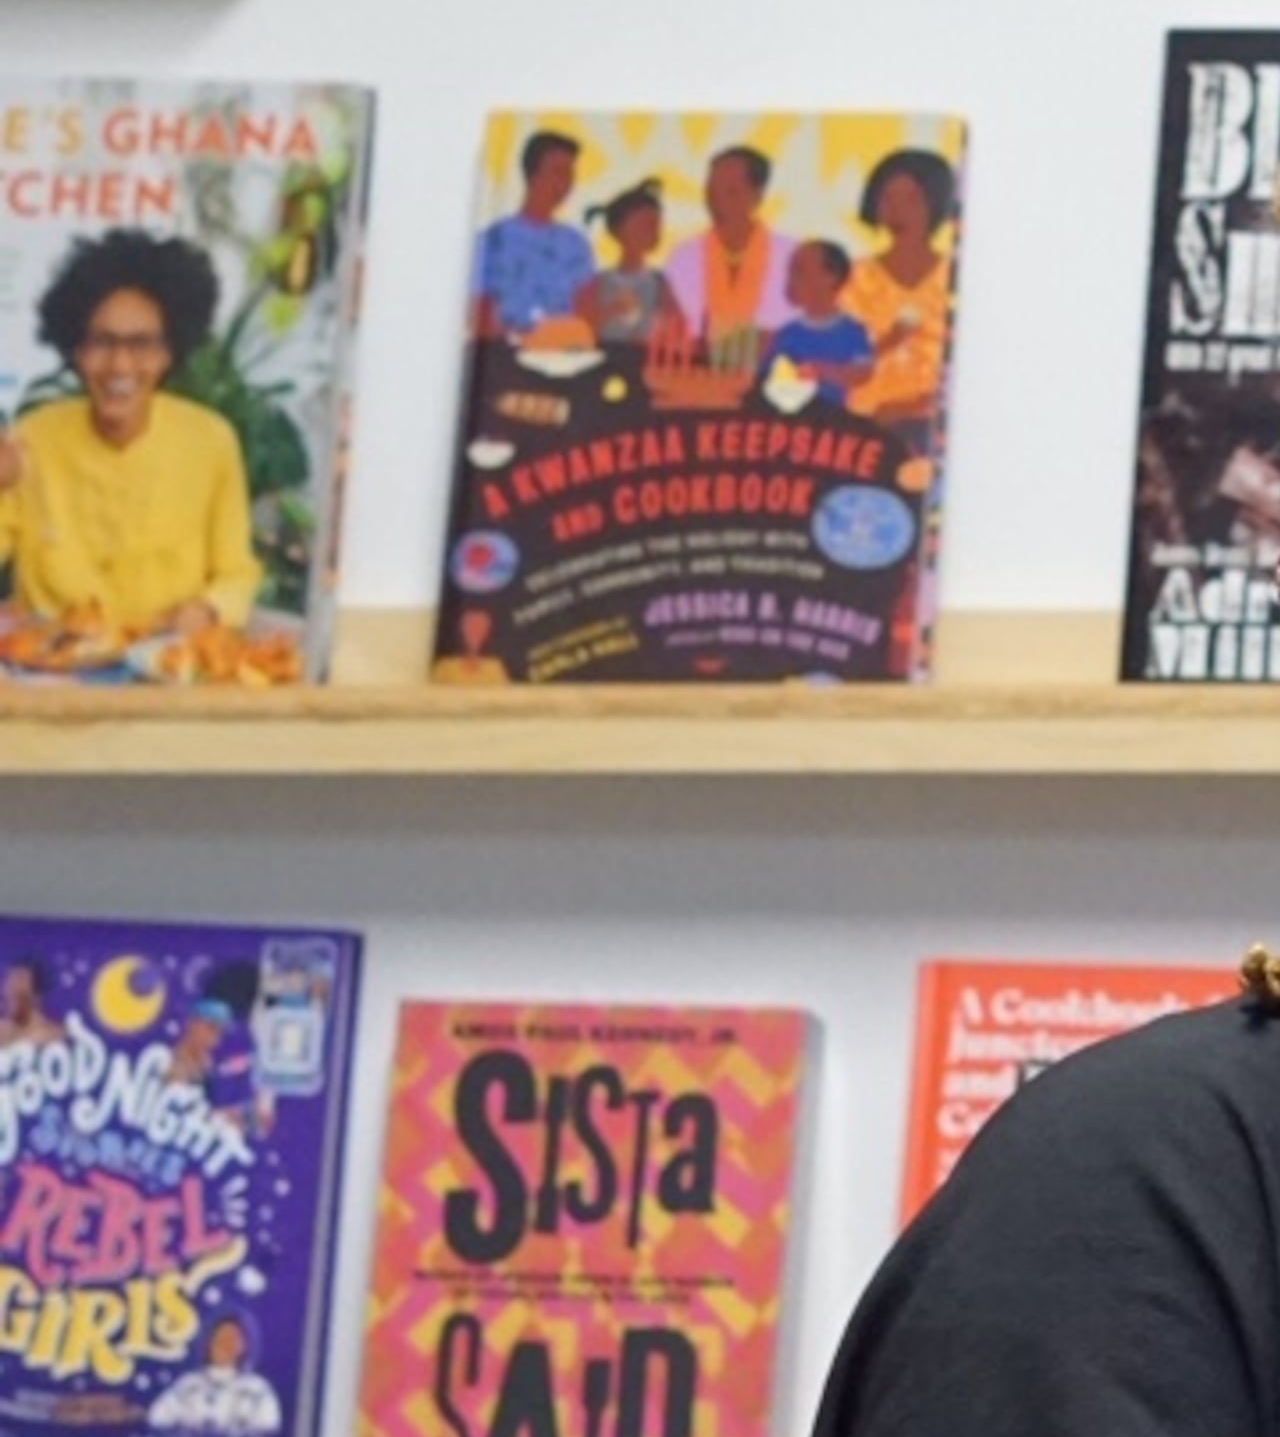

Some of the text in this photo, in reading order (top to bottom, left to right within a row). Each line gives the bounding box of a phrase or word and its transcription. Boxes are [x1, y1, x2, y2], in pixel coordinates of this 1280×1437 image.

[102, 103, 320, 157] GHANA
[0, 169, 177, 219] CHEN
[511, 425, 686, 504] KWANZAA
[697, 420, 884, 480] KEEPSAKE
[613, 471, 816, 525] COOKBOOK
